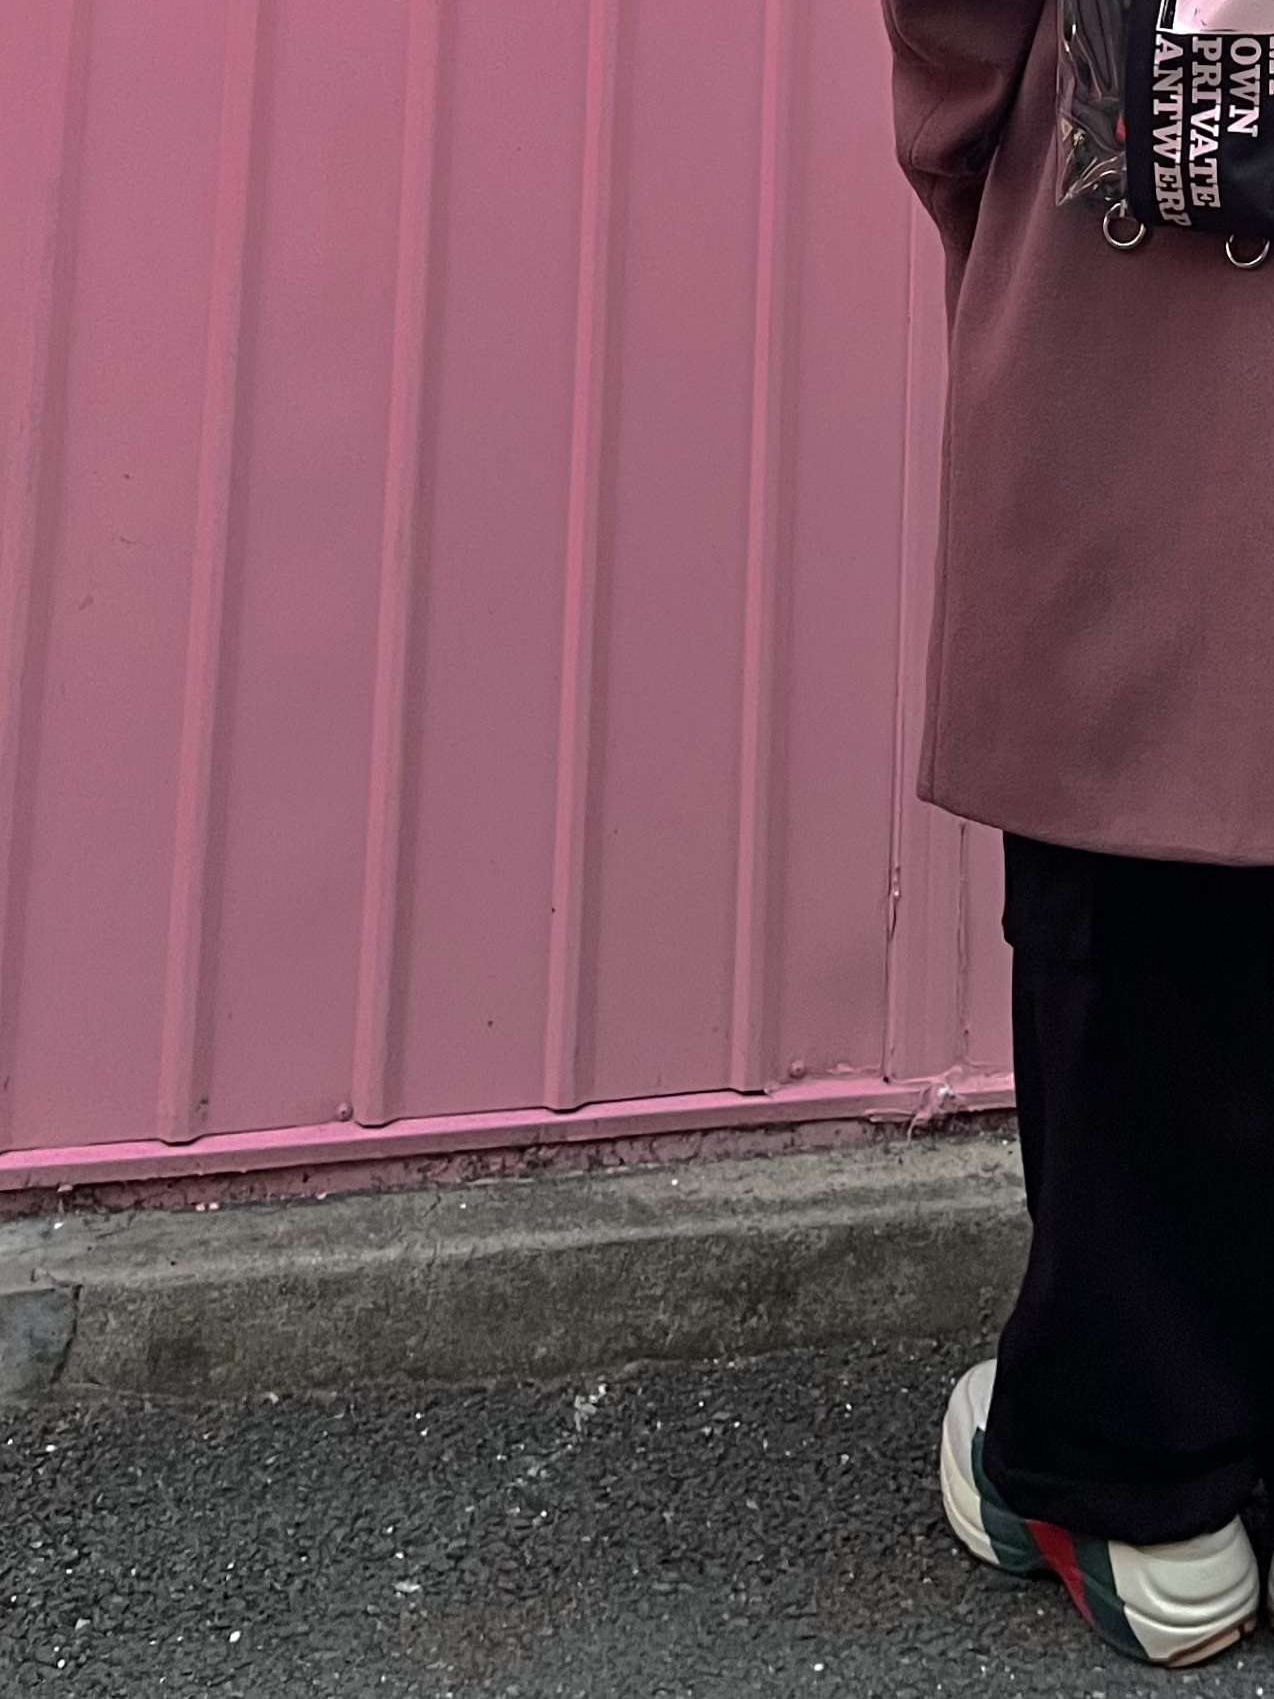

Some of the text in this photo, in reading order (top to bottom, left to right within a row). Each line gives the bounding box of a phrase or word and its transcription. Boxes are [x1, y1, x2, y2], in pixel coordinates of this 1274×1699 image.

[1152, 33, 1192, 227] ANTWERP
[1188, 36, 1223, 208] PRIVATE
[1227, 37, 1262, 138] OWN
